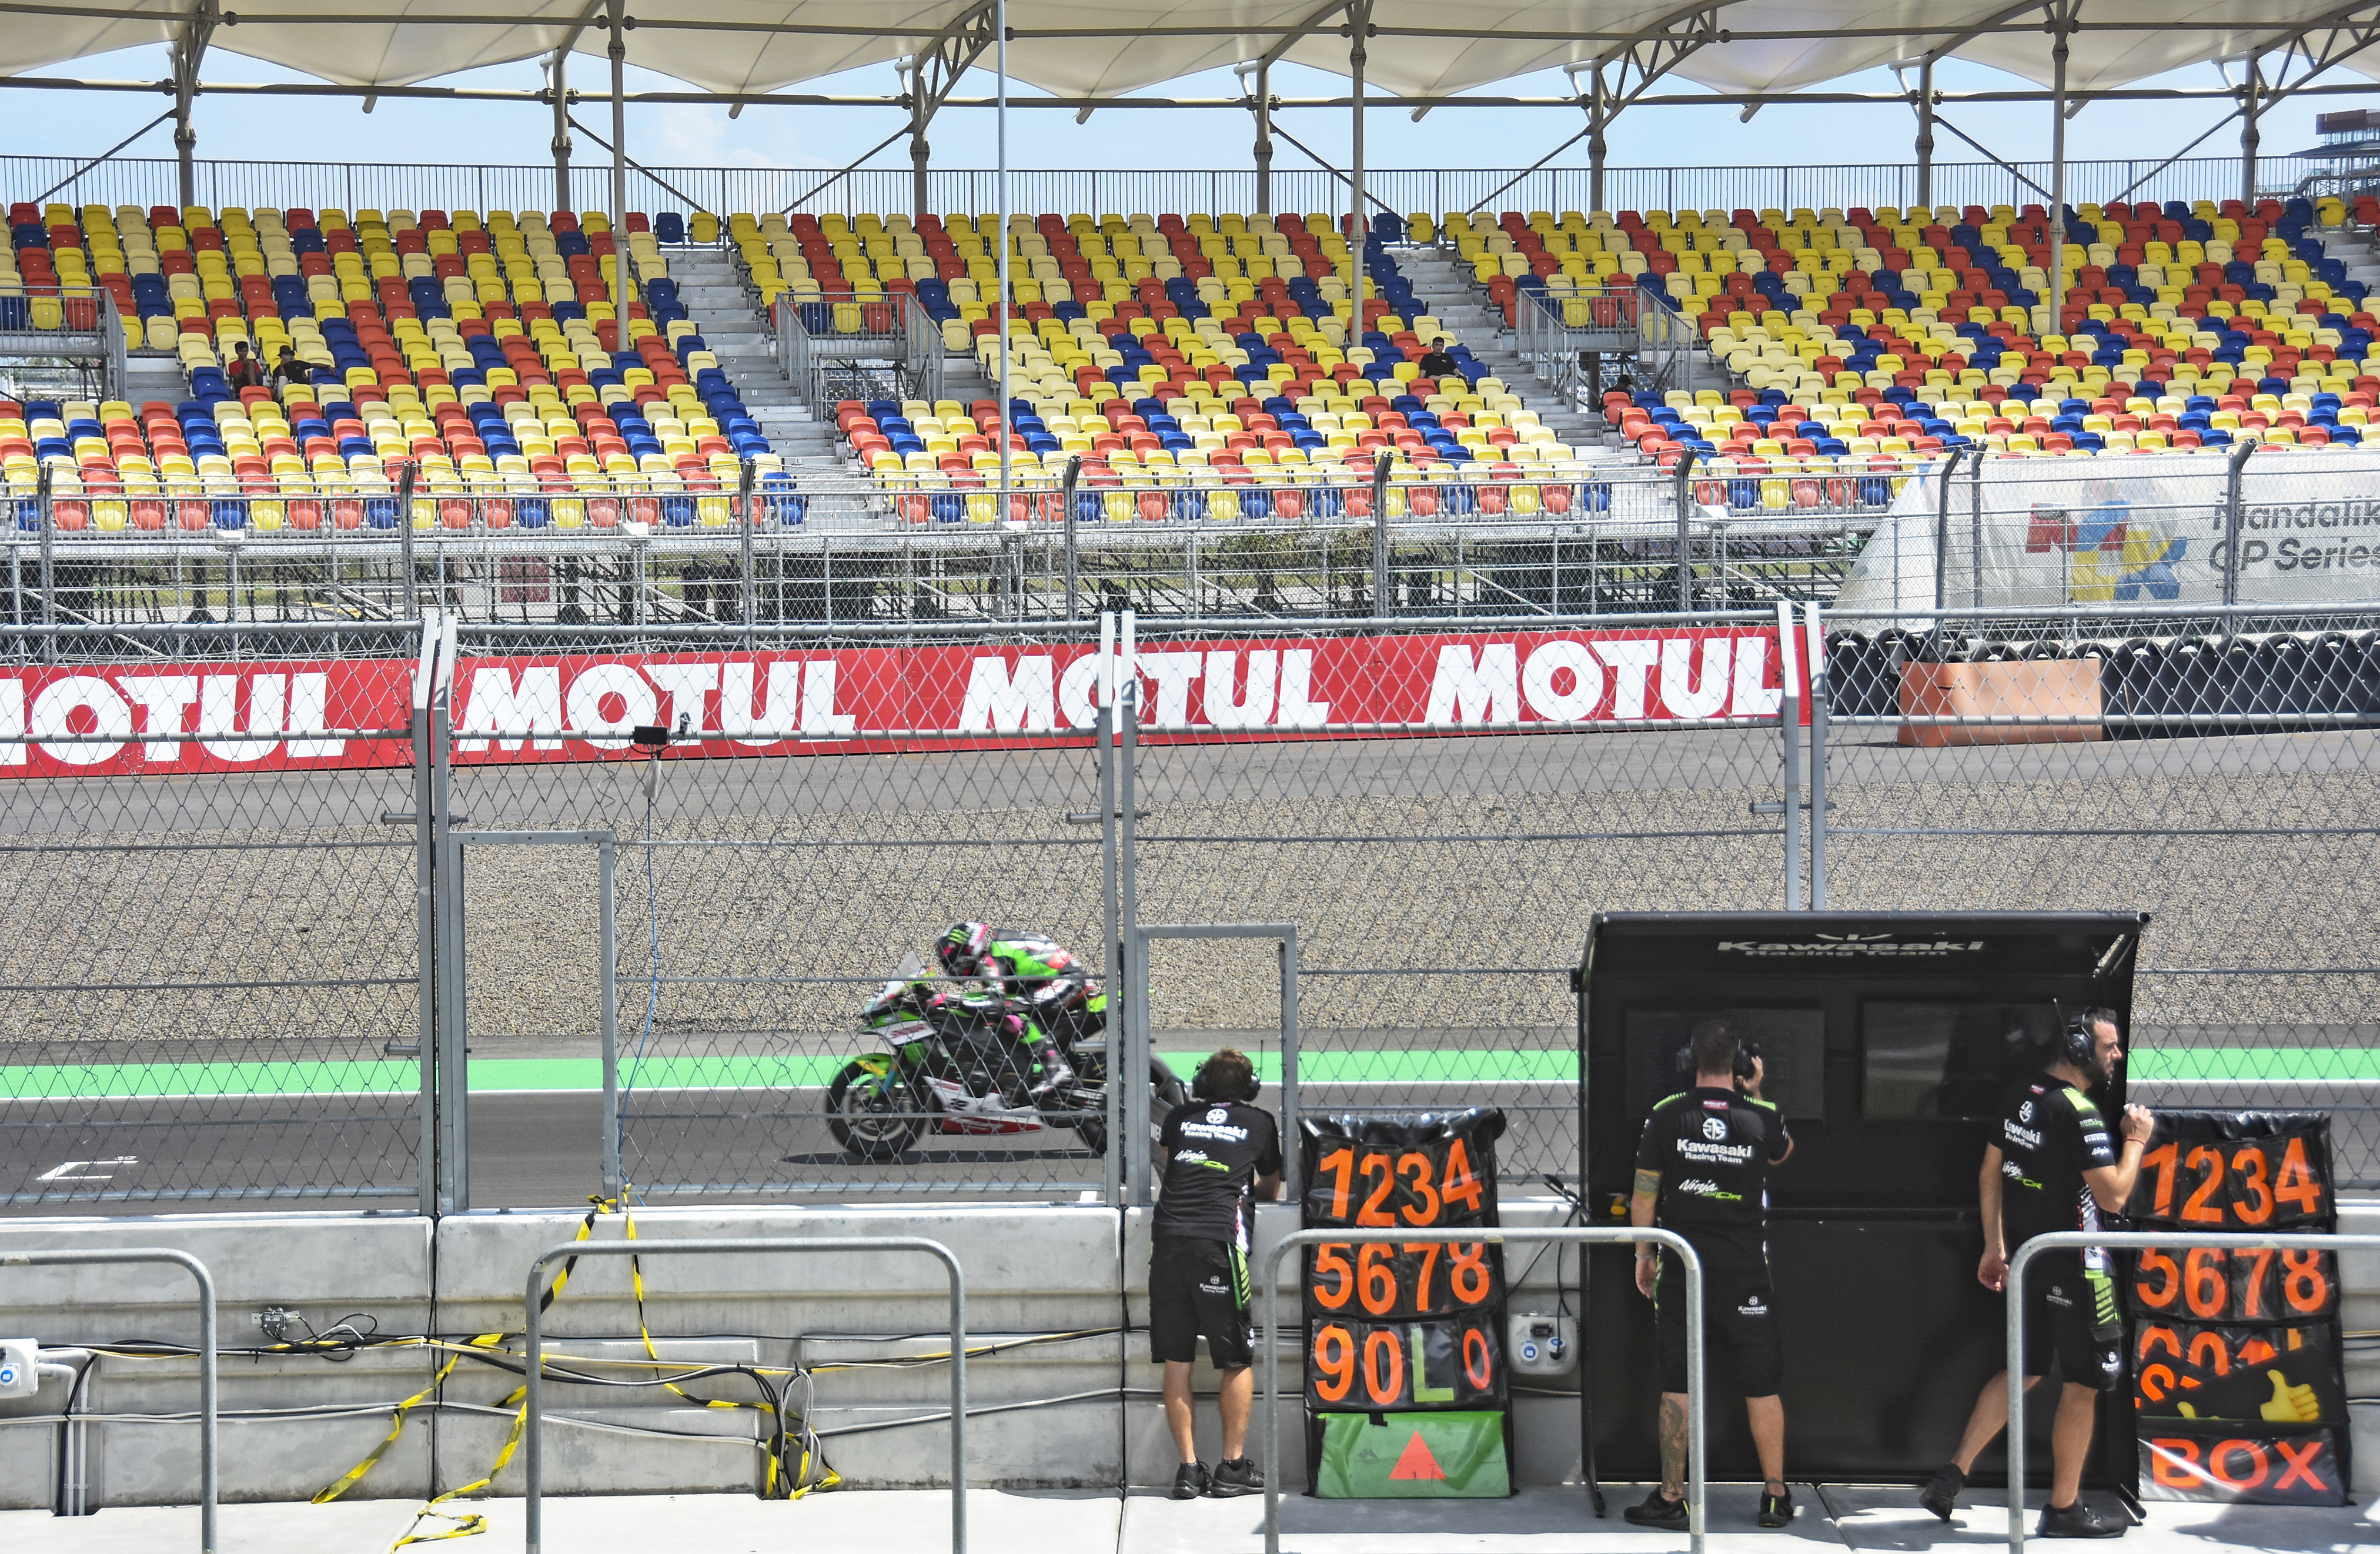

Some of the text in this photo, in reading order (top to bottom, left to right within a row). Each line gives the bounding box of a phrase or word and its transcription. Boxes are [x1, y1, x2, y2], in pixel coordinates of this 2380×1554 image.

[1423, 636, 1783, 724] MOTUL
[959, 649, 1330, 735] MOTUL
[458, 660, 856, 751] MOTUL
[0, 673, 348, 766] OTUL
[1717, 941, 1984, 951] Kawasaki
[1181, 1121, 1248, 1139] Kawasaki
[1184, 1130, 1236, 1142] Racing Team
[1174, 1149, 1209, 1162] Ninja
[1677, 1138, 1752, 1157] Kawasaki
[1684, 1152, 1742, 1164] Racing Team
[1678, 1178, 1718, 1195] Ninja
[1199, 1283, 1229, 1291] Kawasaki
[2151, 1437, 2329, 1491] BOX
